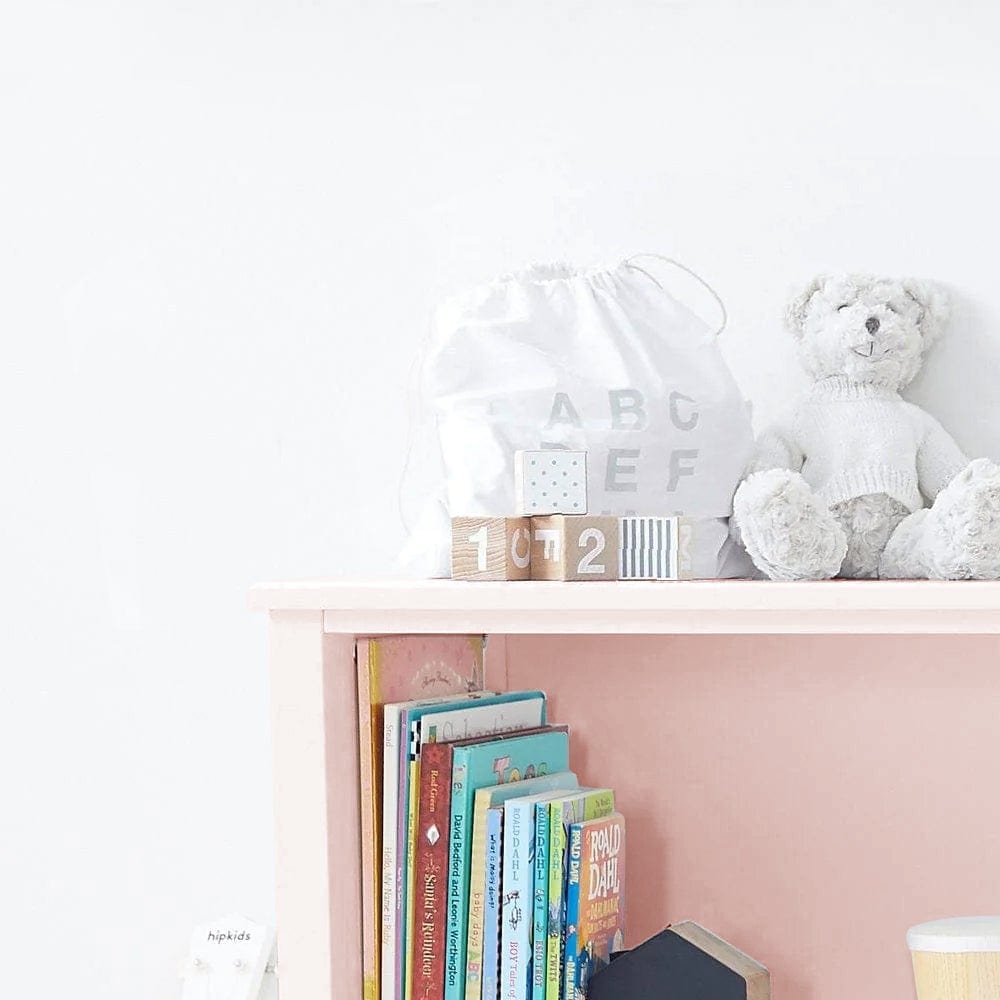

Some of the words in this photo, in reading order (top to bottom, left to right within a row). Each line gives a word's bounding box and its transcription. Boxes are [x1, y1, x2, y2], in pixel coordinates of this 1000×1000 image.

[547, 392, 583, 430] A
[608, 389, 648, 431] B
[668, 390, 700, 431] C
[604, 448, 641, 493] E
[666, 448, 698, 493] F
[468, 526, 488, 572] 1
[577, 527, 606, 573] 2
[385, 724, 394, 747] Stead
[430, 770, 439, 787] Rod
[429, 788, 438, 813] Green
[453, 815, 463, 840] David
[512, 807, 521, 836] ROALD
[536, 807, 546, 835] ROALD
[570, 829, 581, 860] ROALD
[590, 823, 621, 863] ROALD
[452, 842, 462, 877] Bedford
[512, 837, 521, 881] DAHL
[536, 836, 545, 880] DAHL
[552, 837, 561, 880] DAHL
[569, 861, 580, 885] DAHL
[588, 857, 620, 901] DAHL
[383, 888, 393, 912] Name
[423, 873, 438, 920] Santa's
[451, 879, 460, 897] and
[450, 899, 460, 927] Leonie
[471, 892, 480, 918] baby
[207, 930, 251, 944] hipkids
[470, 923, 480, 947] days
[422, 921, 436, 979] Reindeer
[447, 930, 460, 987] Worthington
[509, 941, 518, 963] BOY
[467, 951, 480, 982] ABC
[509, 964, 517, 987] Tales
[549, 954, 558, 982] TWITS
[507, 989, 516, 999] of
